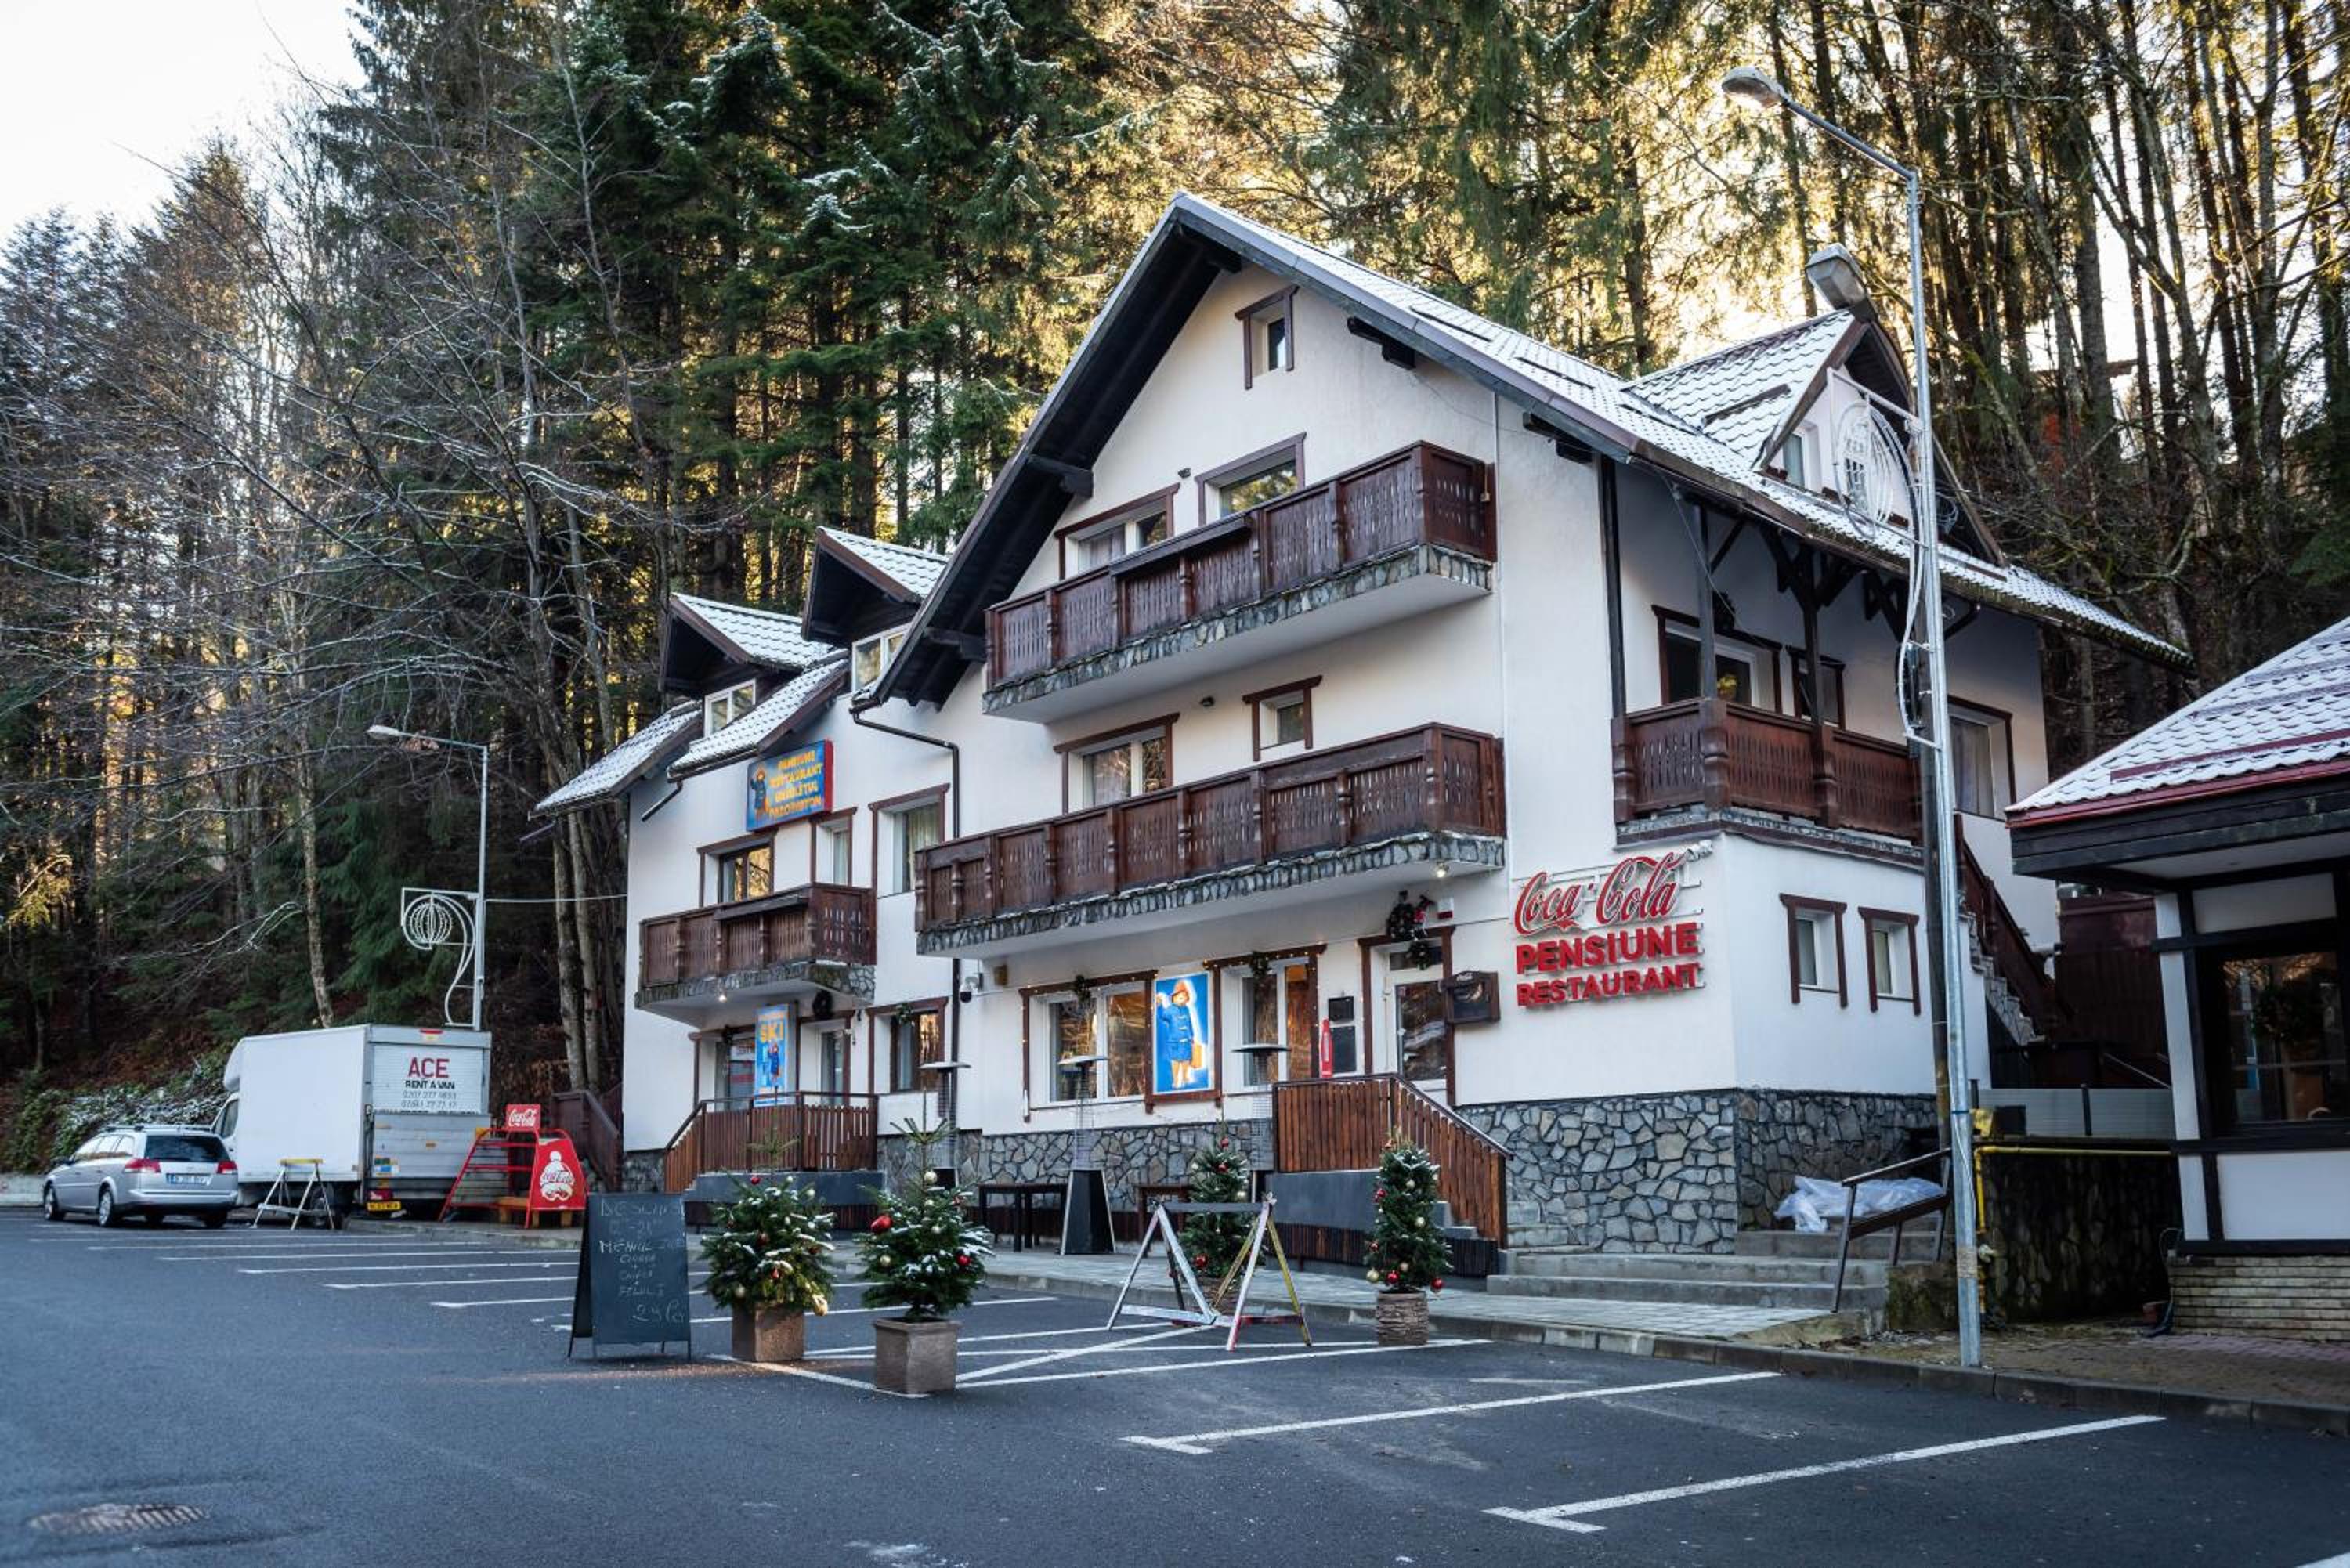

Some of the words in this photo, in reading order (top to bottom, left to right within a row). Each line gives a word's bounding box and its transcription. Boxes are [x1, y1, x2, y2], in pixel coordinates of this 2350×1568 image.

[1516, 922, 1699, 975] PENSIUNE
[1516, 962, 1701, 1007] RESTAURANT
[761, 1021, 784, 1043] SKI
[407, 1057, 450, 1078] ACE
[405, 1080, 428, 1089] RENT
[430, 1081, 437, 1089] A
[438, 1081, 456, 1090] VAN
